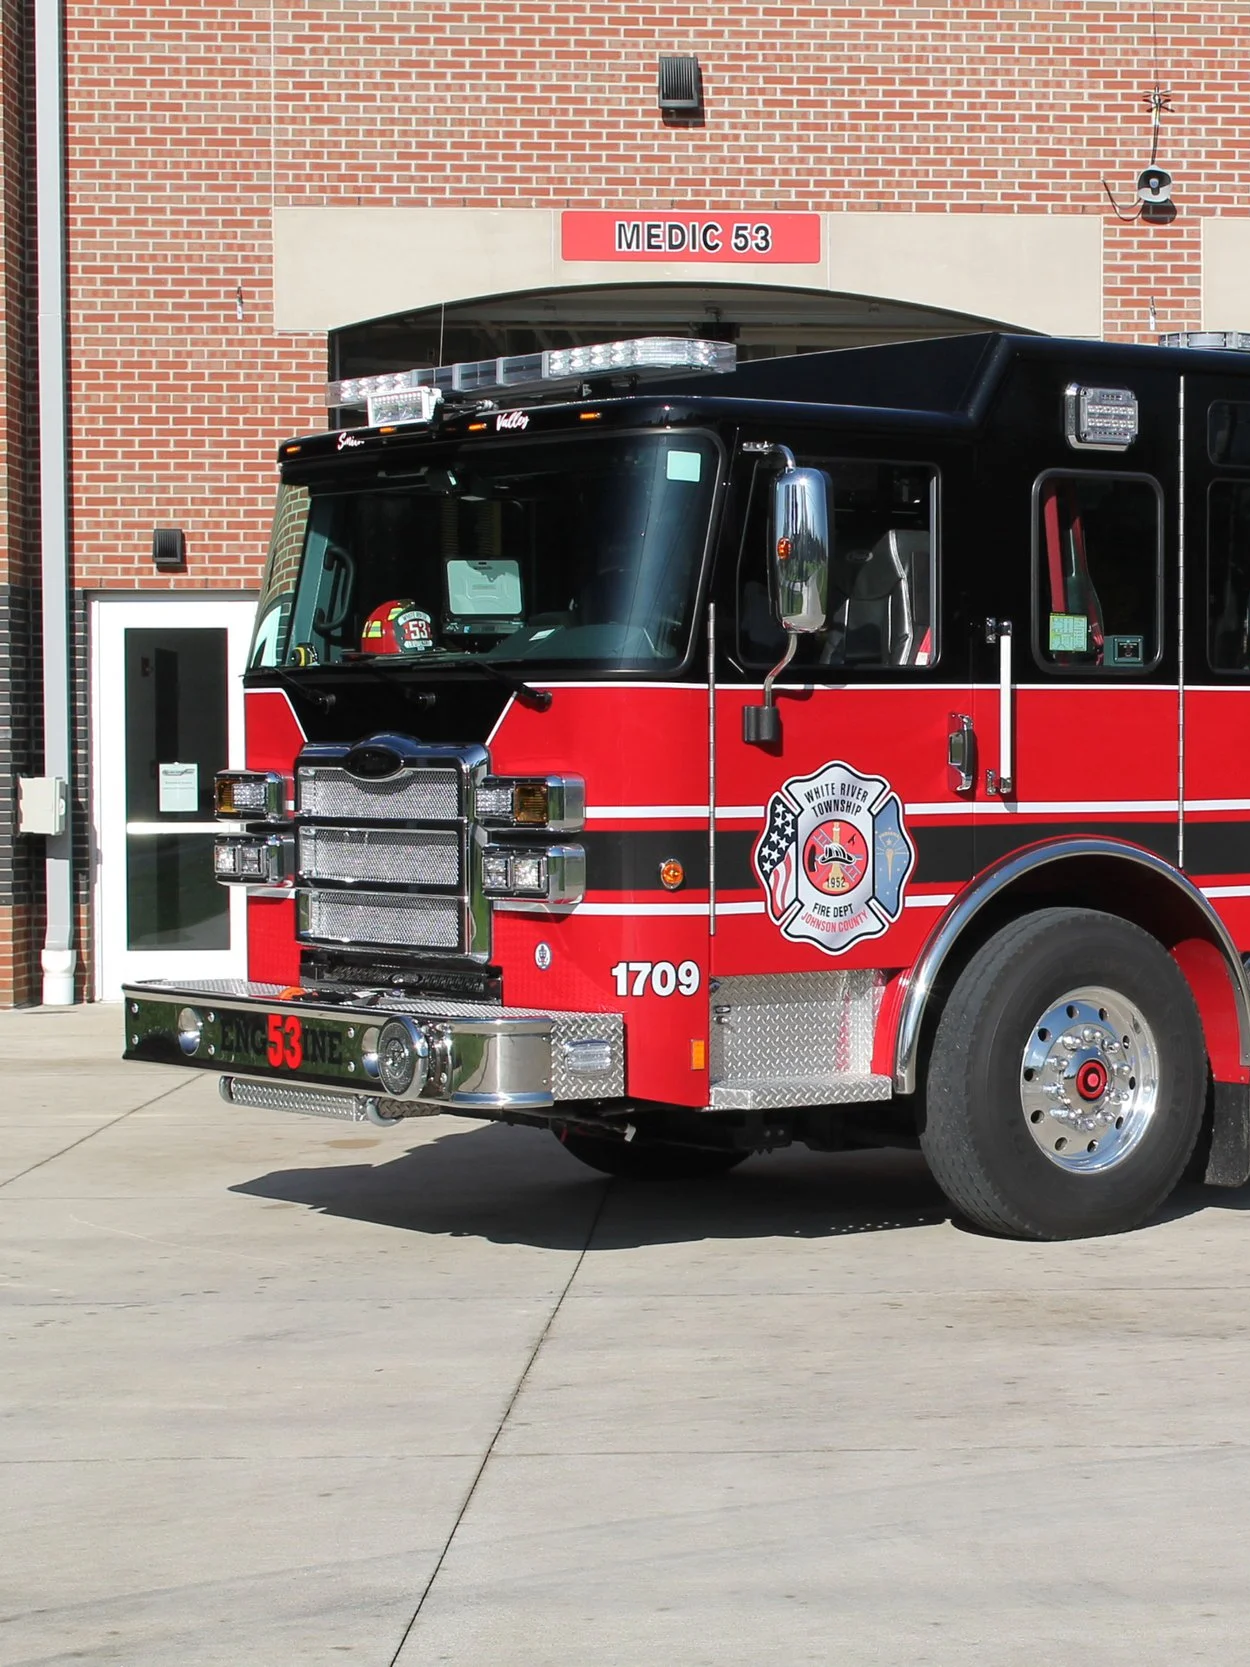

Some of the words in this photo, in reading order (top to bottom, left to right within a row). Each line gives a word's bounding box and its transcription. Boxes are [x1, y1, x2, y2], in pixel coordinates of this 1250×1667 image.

[615, 221, 722, 252] MEDIC
[731, 223, 772, 253] 53
[496, 411, 530, 431] Valley
[408, 620, 429, 640] 53
[804, 783, 835, 803] WHITE
[840, 783, 869, 803] RIVER
[811, 800, 862, 817] TOWNSHIP
[826, 876, 846, 888] 1952
[812, 902, 831, 918] FIRE
[833, 903, 854, 918] DEPT
[801, 911, 837, 932] JOHNSON
[838, 910, 868, 933] COUNTY
[611, 960, 700, 997] 1709
[267, 1013, 303, 1069] 53
